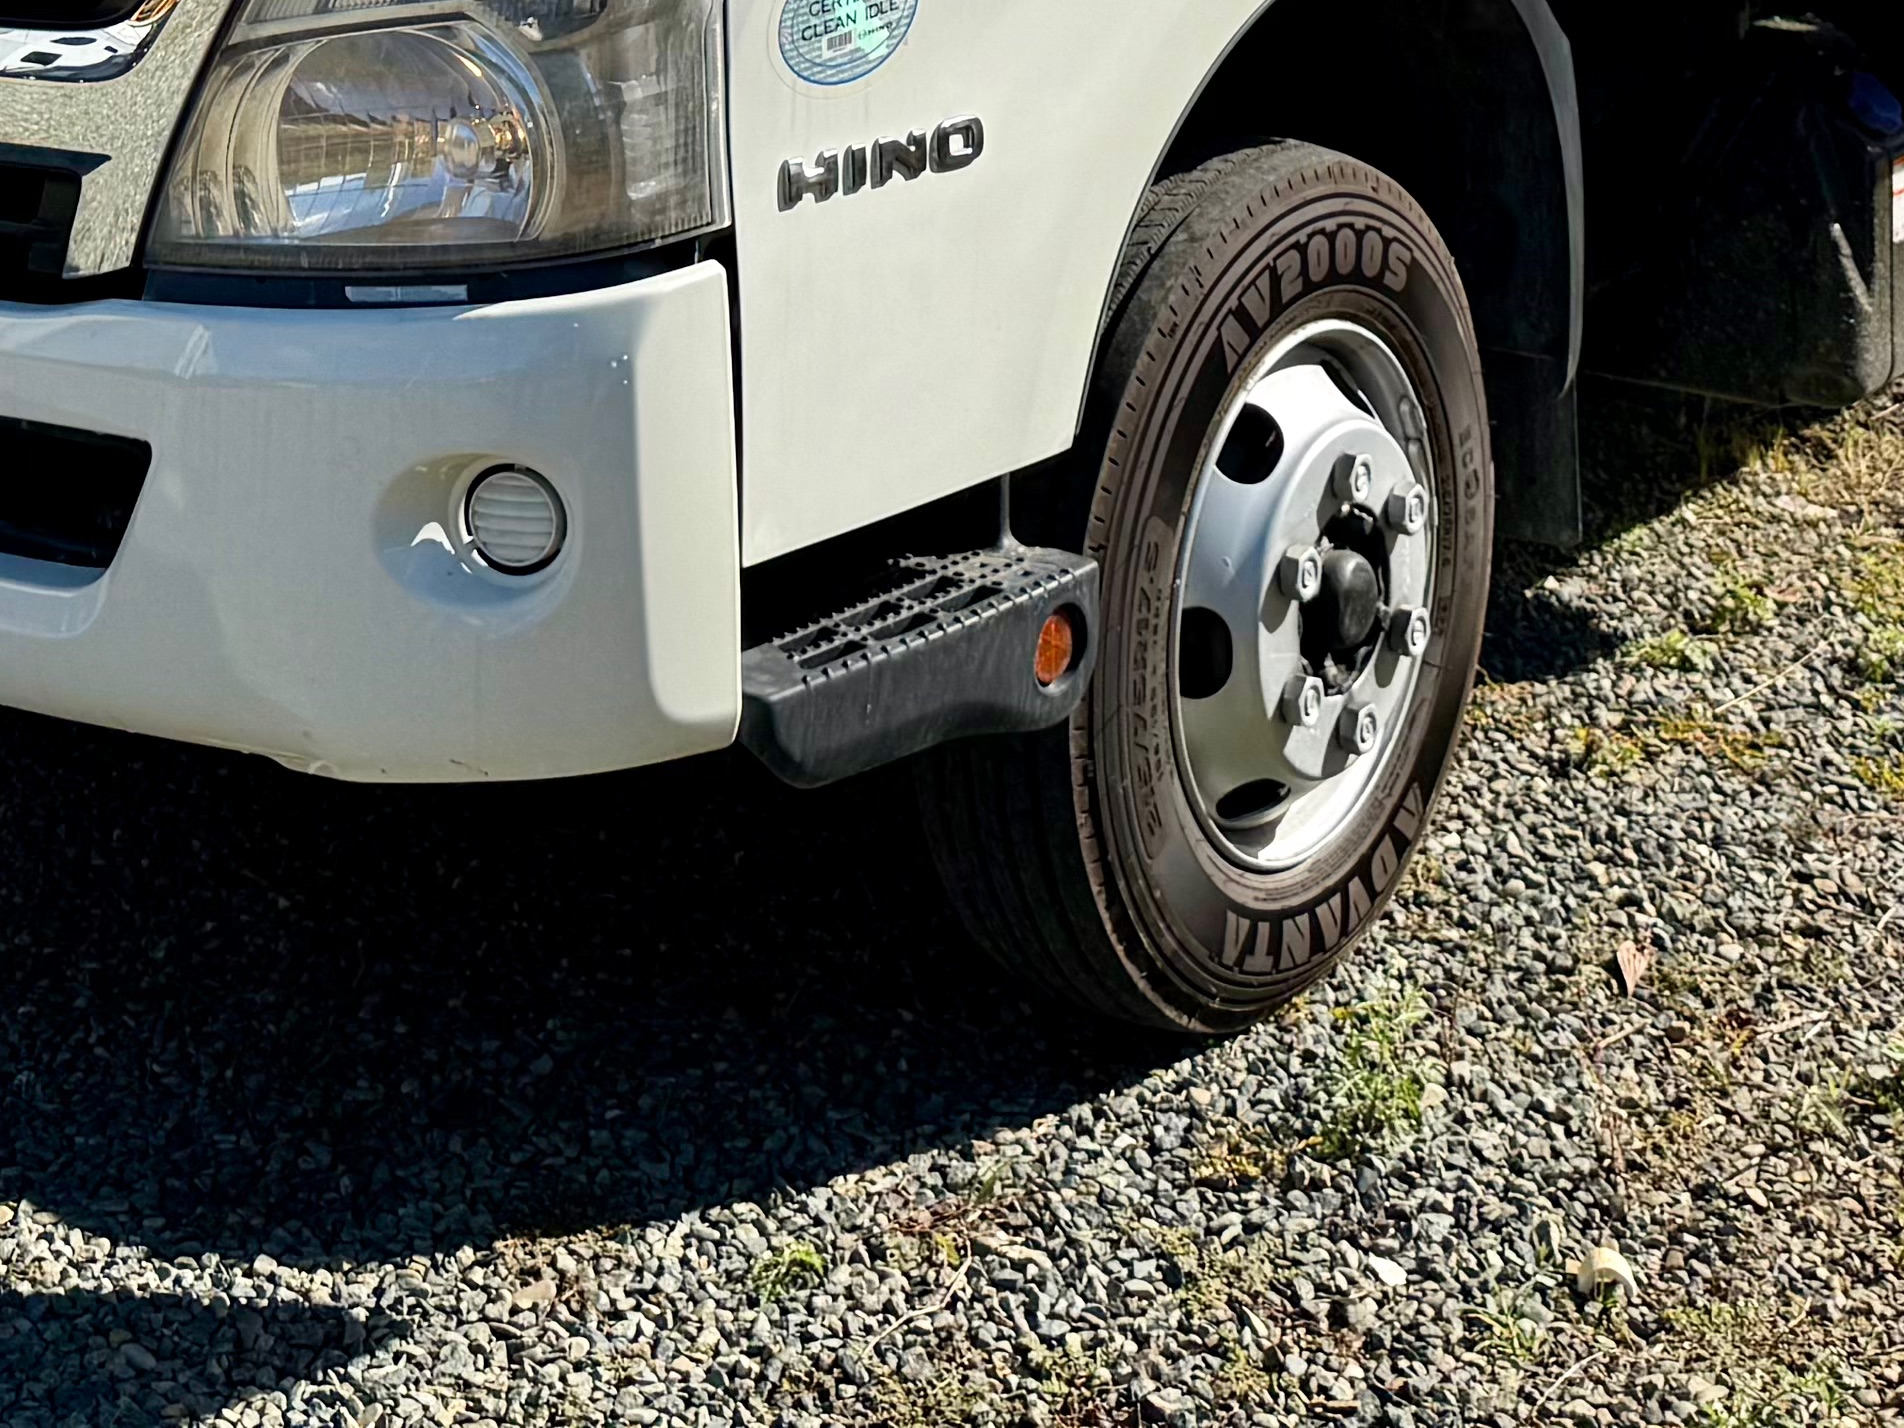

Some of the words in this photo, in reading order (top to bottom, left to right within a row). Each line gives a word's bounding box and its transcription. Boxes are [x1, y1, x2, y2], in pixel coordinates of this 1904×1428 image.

[801, 10, 857, 41] CLEAN
[777, 113, 985, 213] HINO
[1219, 227, 1414, 375] AV2000S
[1221, 781, 1424, 974] ADVANTA
